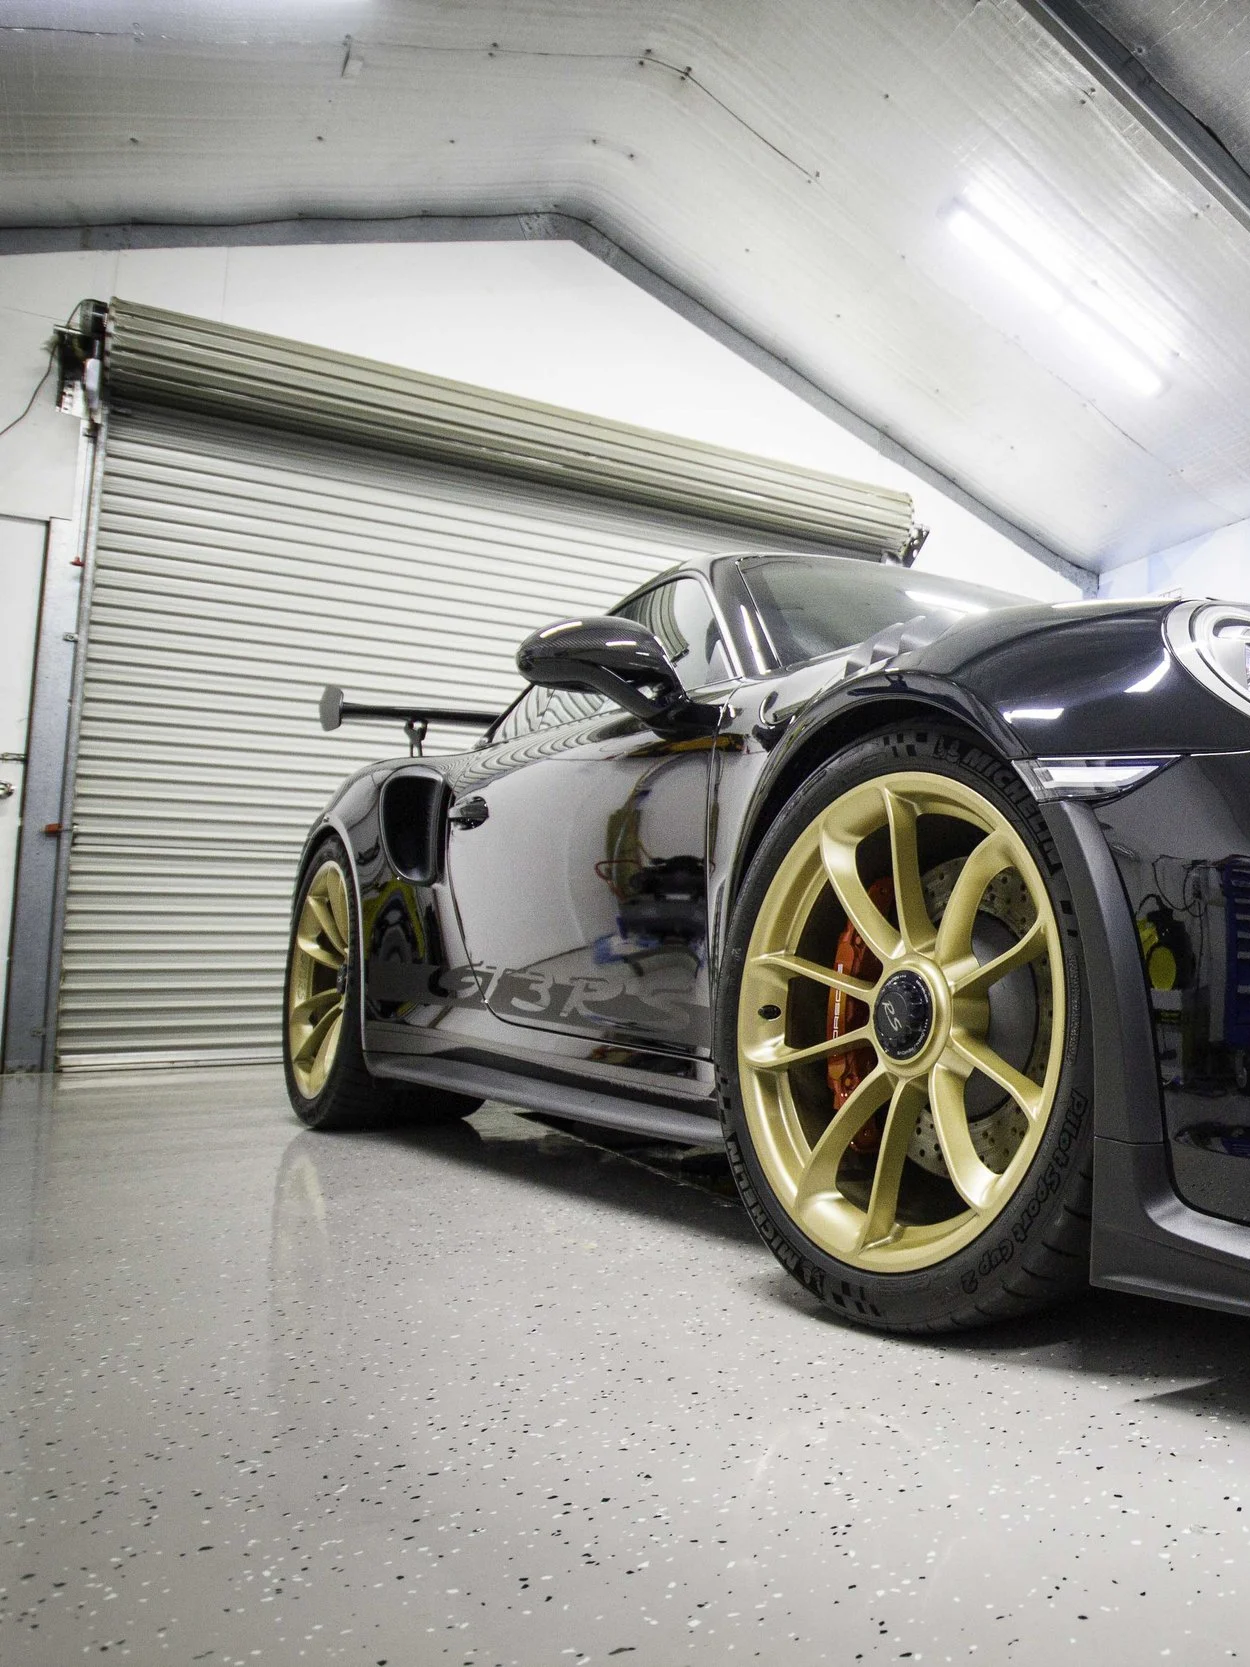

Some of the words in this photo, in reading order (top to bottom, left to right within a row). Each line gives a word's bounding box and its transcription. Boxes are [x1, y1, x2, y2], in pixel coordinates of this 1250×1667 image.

[1052, 1088, 1089, 1168] Pilot
[725, 1141, 801, 1270] MICHELIN
[1011, 1164, 1061, 1244] Sport
[960, 1269, 979, 1294] 2
[978, 1238, 1015, 1276] Cup
